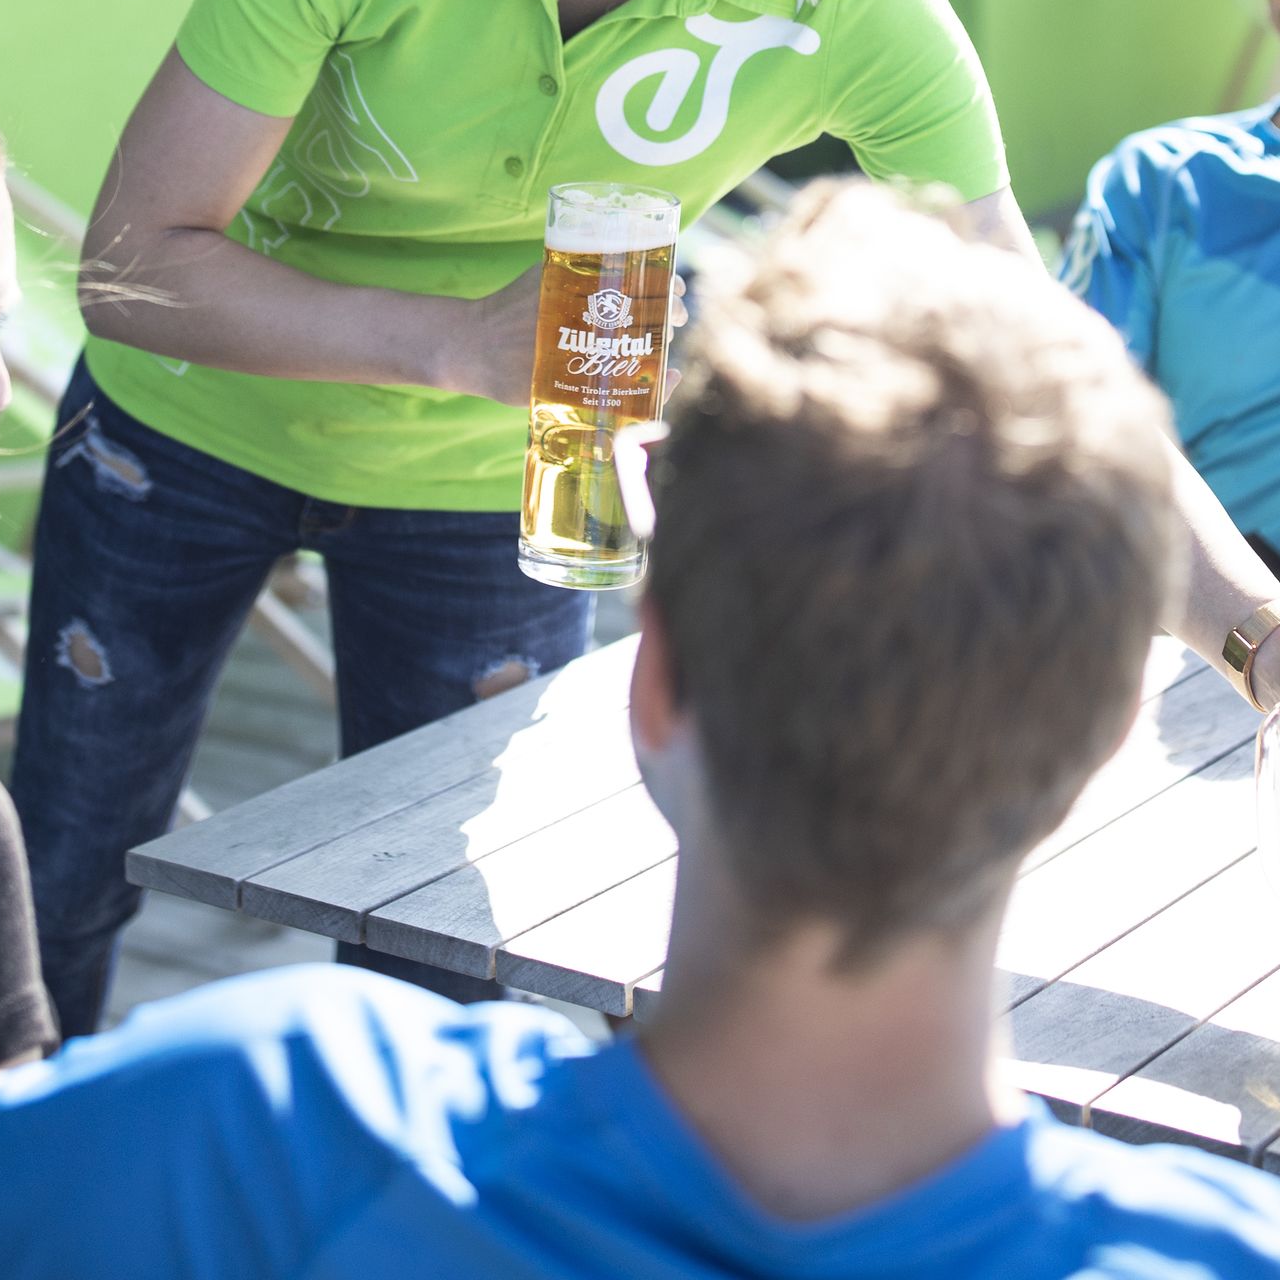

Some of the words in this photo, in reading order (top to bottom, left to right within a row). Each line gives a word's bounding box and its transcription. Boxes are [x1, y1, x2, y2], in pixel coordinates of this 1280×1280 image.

[558, 326, 653, 358] Zillertal
[567, 351, 641, 376] Bier
[554, 380, 579, 393] Feinste
[581, 385, 610, 396] Tiroler
[612, 387, 650, 396] Bierkultur
[582, 397, 599, 406] Seit
[601, 398, 622, 407] 1500
